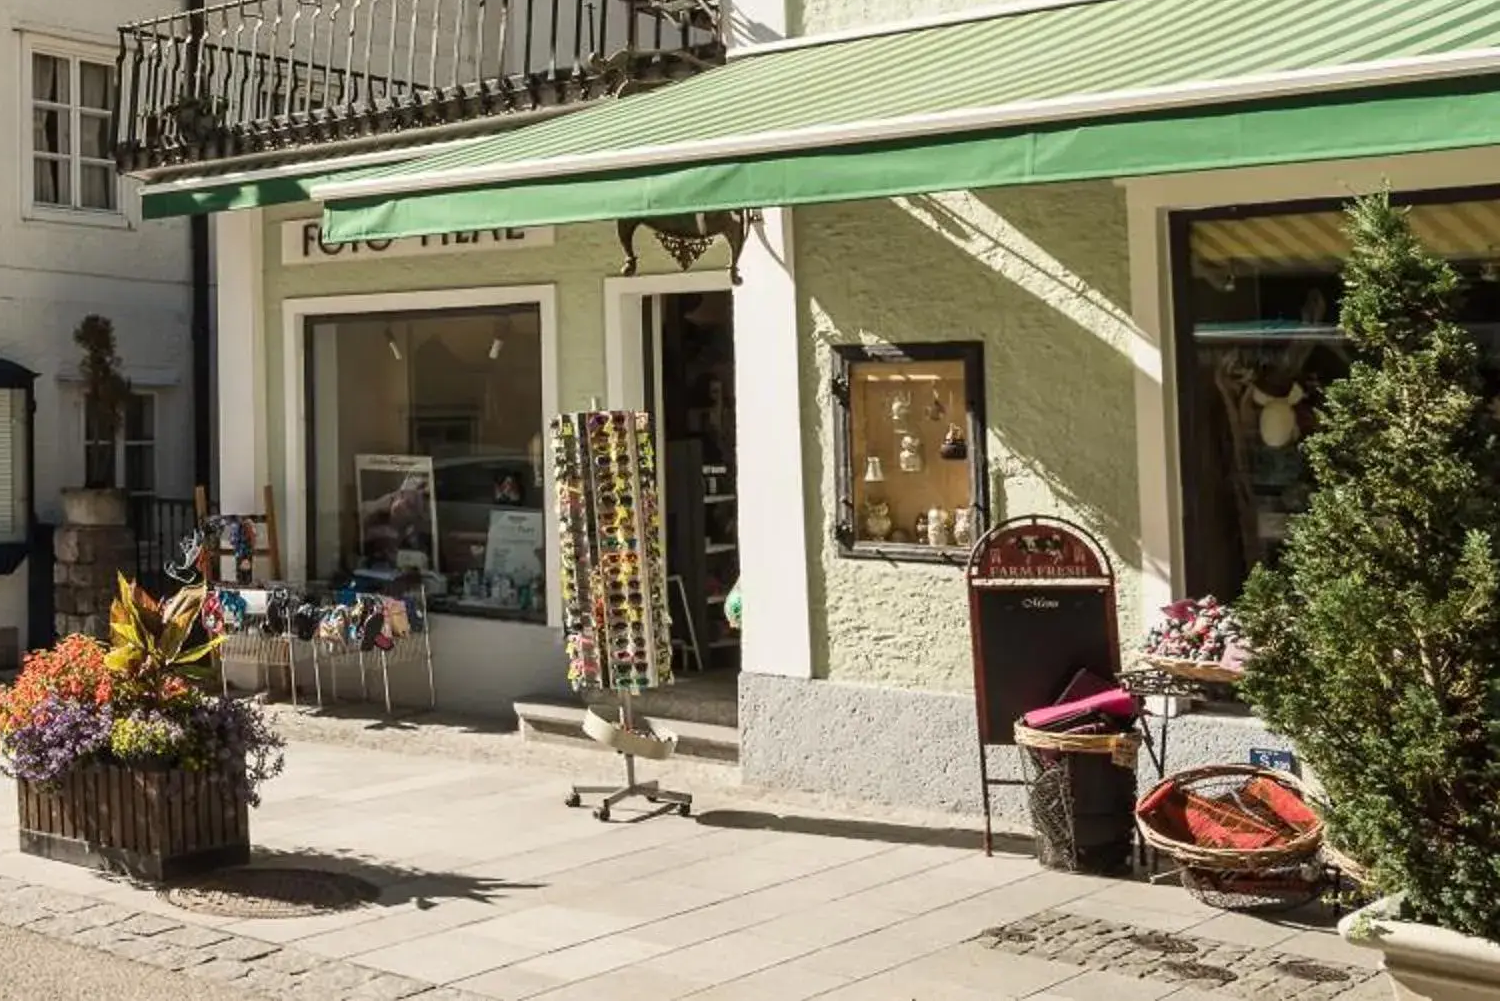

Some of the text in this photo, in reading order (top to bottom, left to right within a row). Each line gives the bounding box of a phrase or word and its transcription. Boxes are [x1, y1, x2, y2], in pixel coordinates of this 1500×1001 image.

[989, 565, 1088, 577] FARM FRESH
[1021, 597, 1060, 609] Menu
